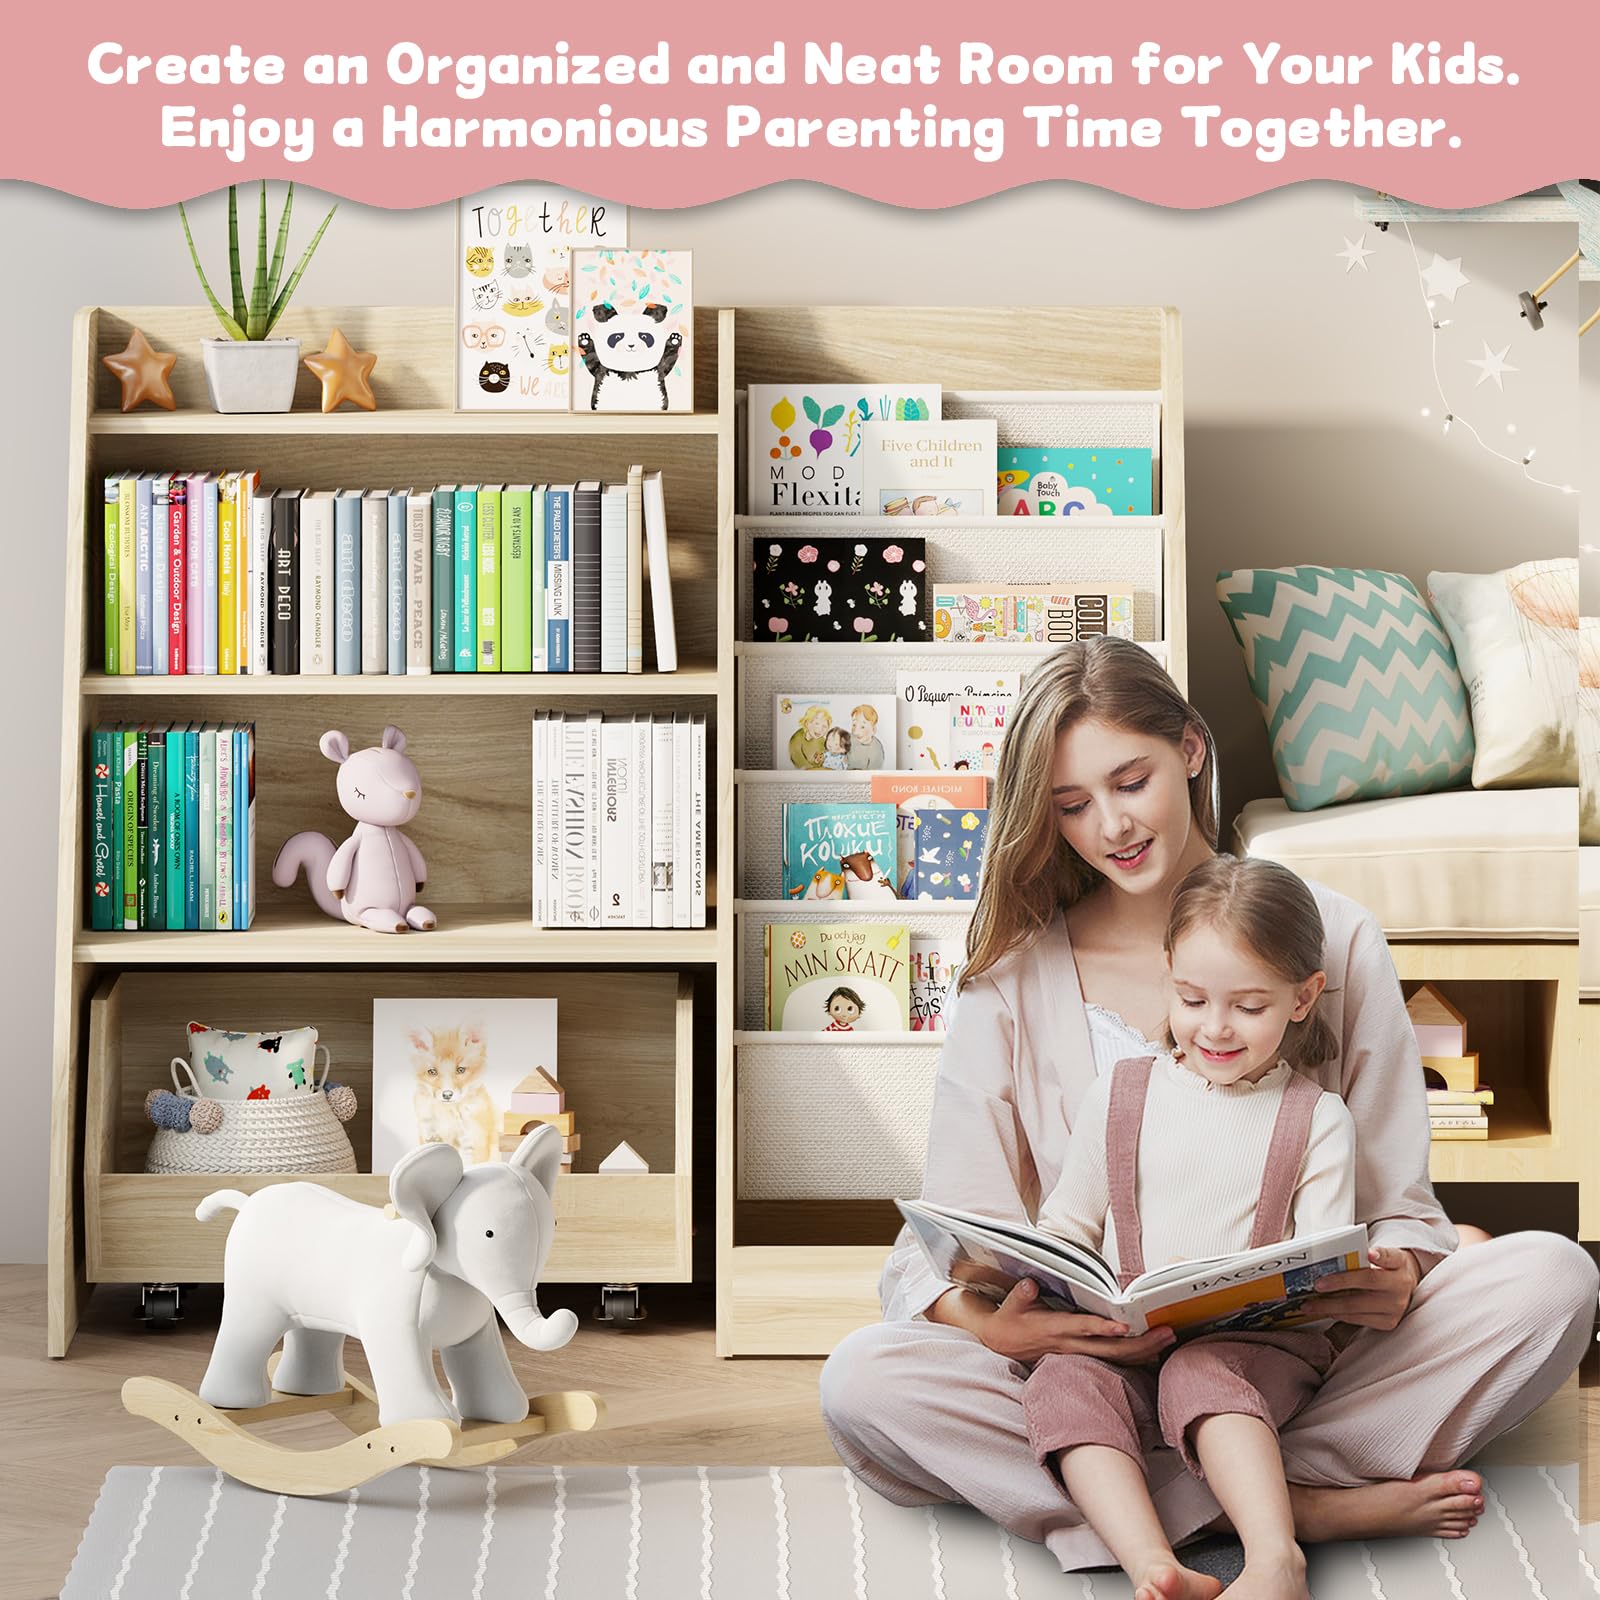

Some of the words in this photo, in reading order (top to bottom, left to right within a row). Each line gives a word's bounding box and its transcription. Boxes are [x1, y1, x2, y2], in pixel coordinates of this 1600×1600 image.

[881, 439, 912, 452] Five
[916, 439, 983, 452] Children
[910, 455, 938, 467] and
[944, 455, 953, 467] It
[1036, 489, 1060, 497] Touch
[1037, 481, 1058, 490] Baby
[482, 502, 495, 516] LESS
[512, 506, 522, 518] ANS
[553, 496, 561, 509] THE
[173, 511, 181, 545] Garden
[190, 498, 198, 538] LUXURY
[223, 520, 231, 541] Cool
[412, 508, 424, 544] TOLSTOY
[436, 507, 452, 536] ELEANOR
[553, 510, 561, 530] PALEO
[108, 523, 116, 569] Ecological
[139, 504, 149, 572] ANTARCTIC
[436, 536, 452, 557] RIGBY
[223, 544, 231, 574] Hotels
[277, 548, 291, 576] ART
[413, 548, 423, 585] WAR
[108, 572, 116, 605] Design
[173, 559, 181, 599] Outdoor
[222, 580, 231, 596] Italy
[554, 564, 562, 597] MISSING
[277, 586, 291, 620] DECO
[554, 598, 562, 616] LINK
[172, 603, 181, 634] Design
[413, 600, 423, 649] PEACE
[1048, 609, 1073, 642] BOO
[905, 685, 914, 702] O
[150, 761, 160, 795] Dreaming
[95, 784, 108, 820] Hansel
[114, 781, 122, 805] Pasta
[152, 796, 160, 804] of
[96, 822, 107, 841] and
[127, 822, 134, 834] OF
[152, 804, 160, 832] Sweden
[174, 820, 180, 831] OF
[95, 842, 109, 878] Gretel
[820, 932, 832, 943] Du
[834, 930, 849, 940] och
[849, 933, 866, 944] jag
[784, 950, 828, 987] MIN
[834, 946, 904, 983] SKATT
[924, 981, 946, 996] the
[910, 997, 944, 1024] fas
[1191, 1252, 1308, 1292] BACON
